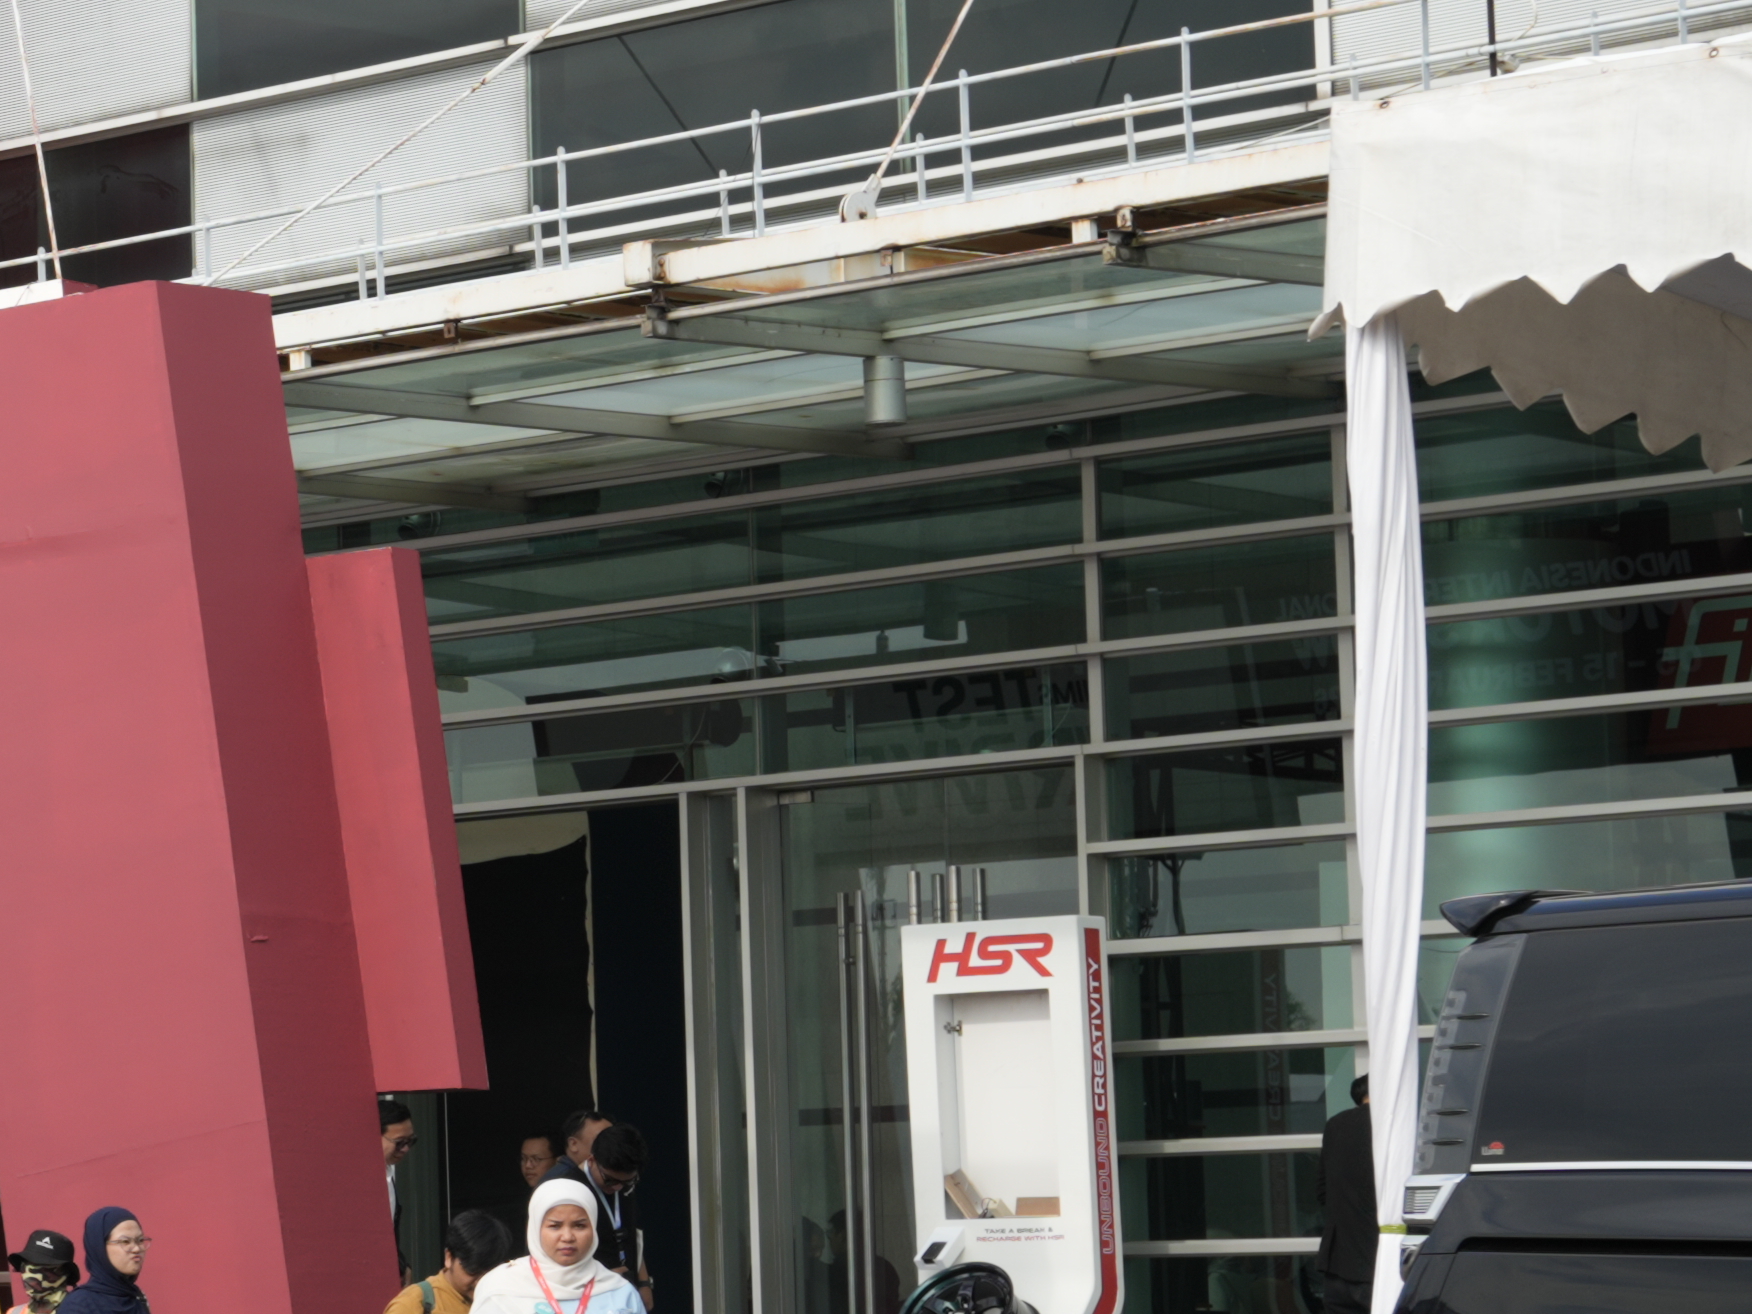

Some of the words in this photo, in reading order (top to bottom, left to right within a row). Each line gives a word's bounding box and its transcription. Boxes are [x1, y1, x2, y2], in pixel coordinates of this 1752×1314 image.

[926, 931, 1055, 983] HSR
[1086, 955, 1107, 1113] CREATIVITY
[1096, 1117, 1115, 1256] UNBOUND
[976, 1235, 1022, 1243] RECHARGE
